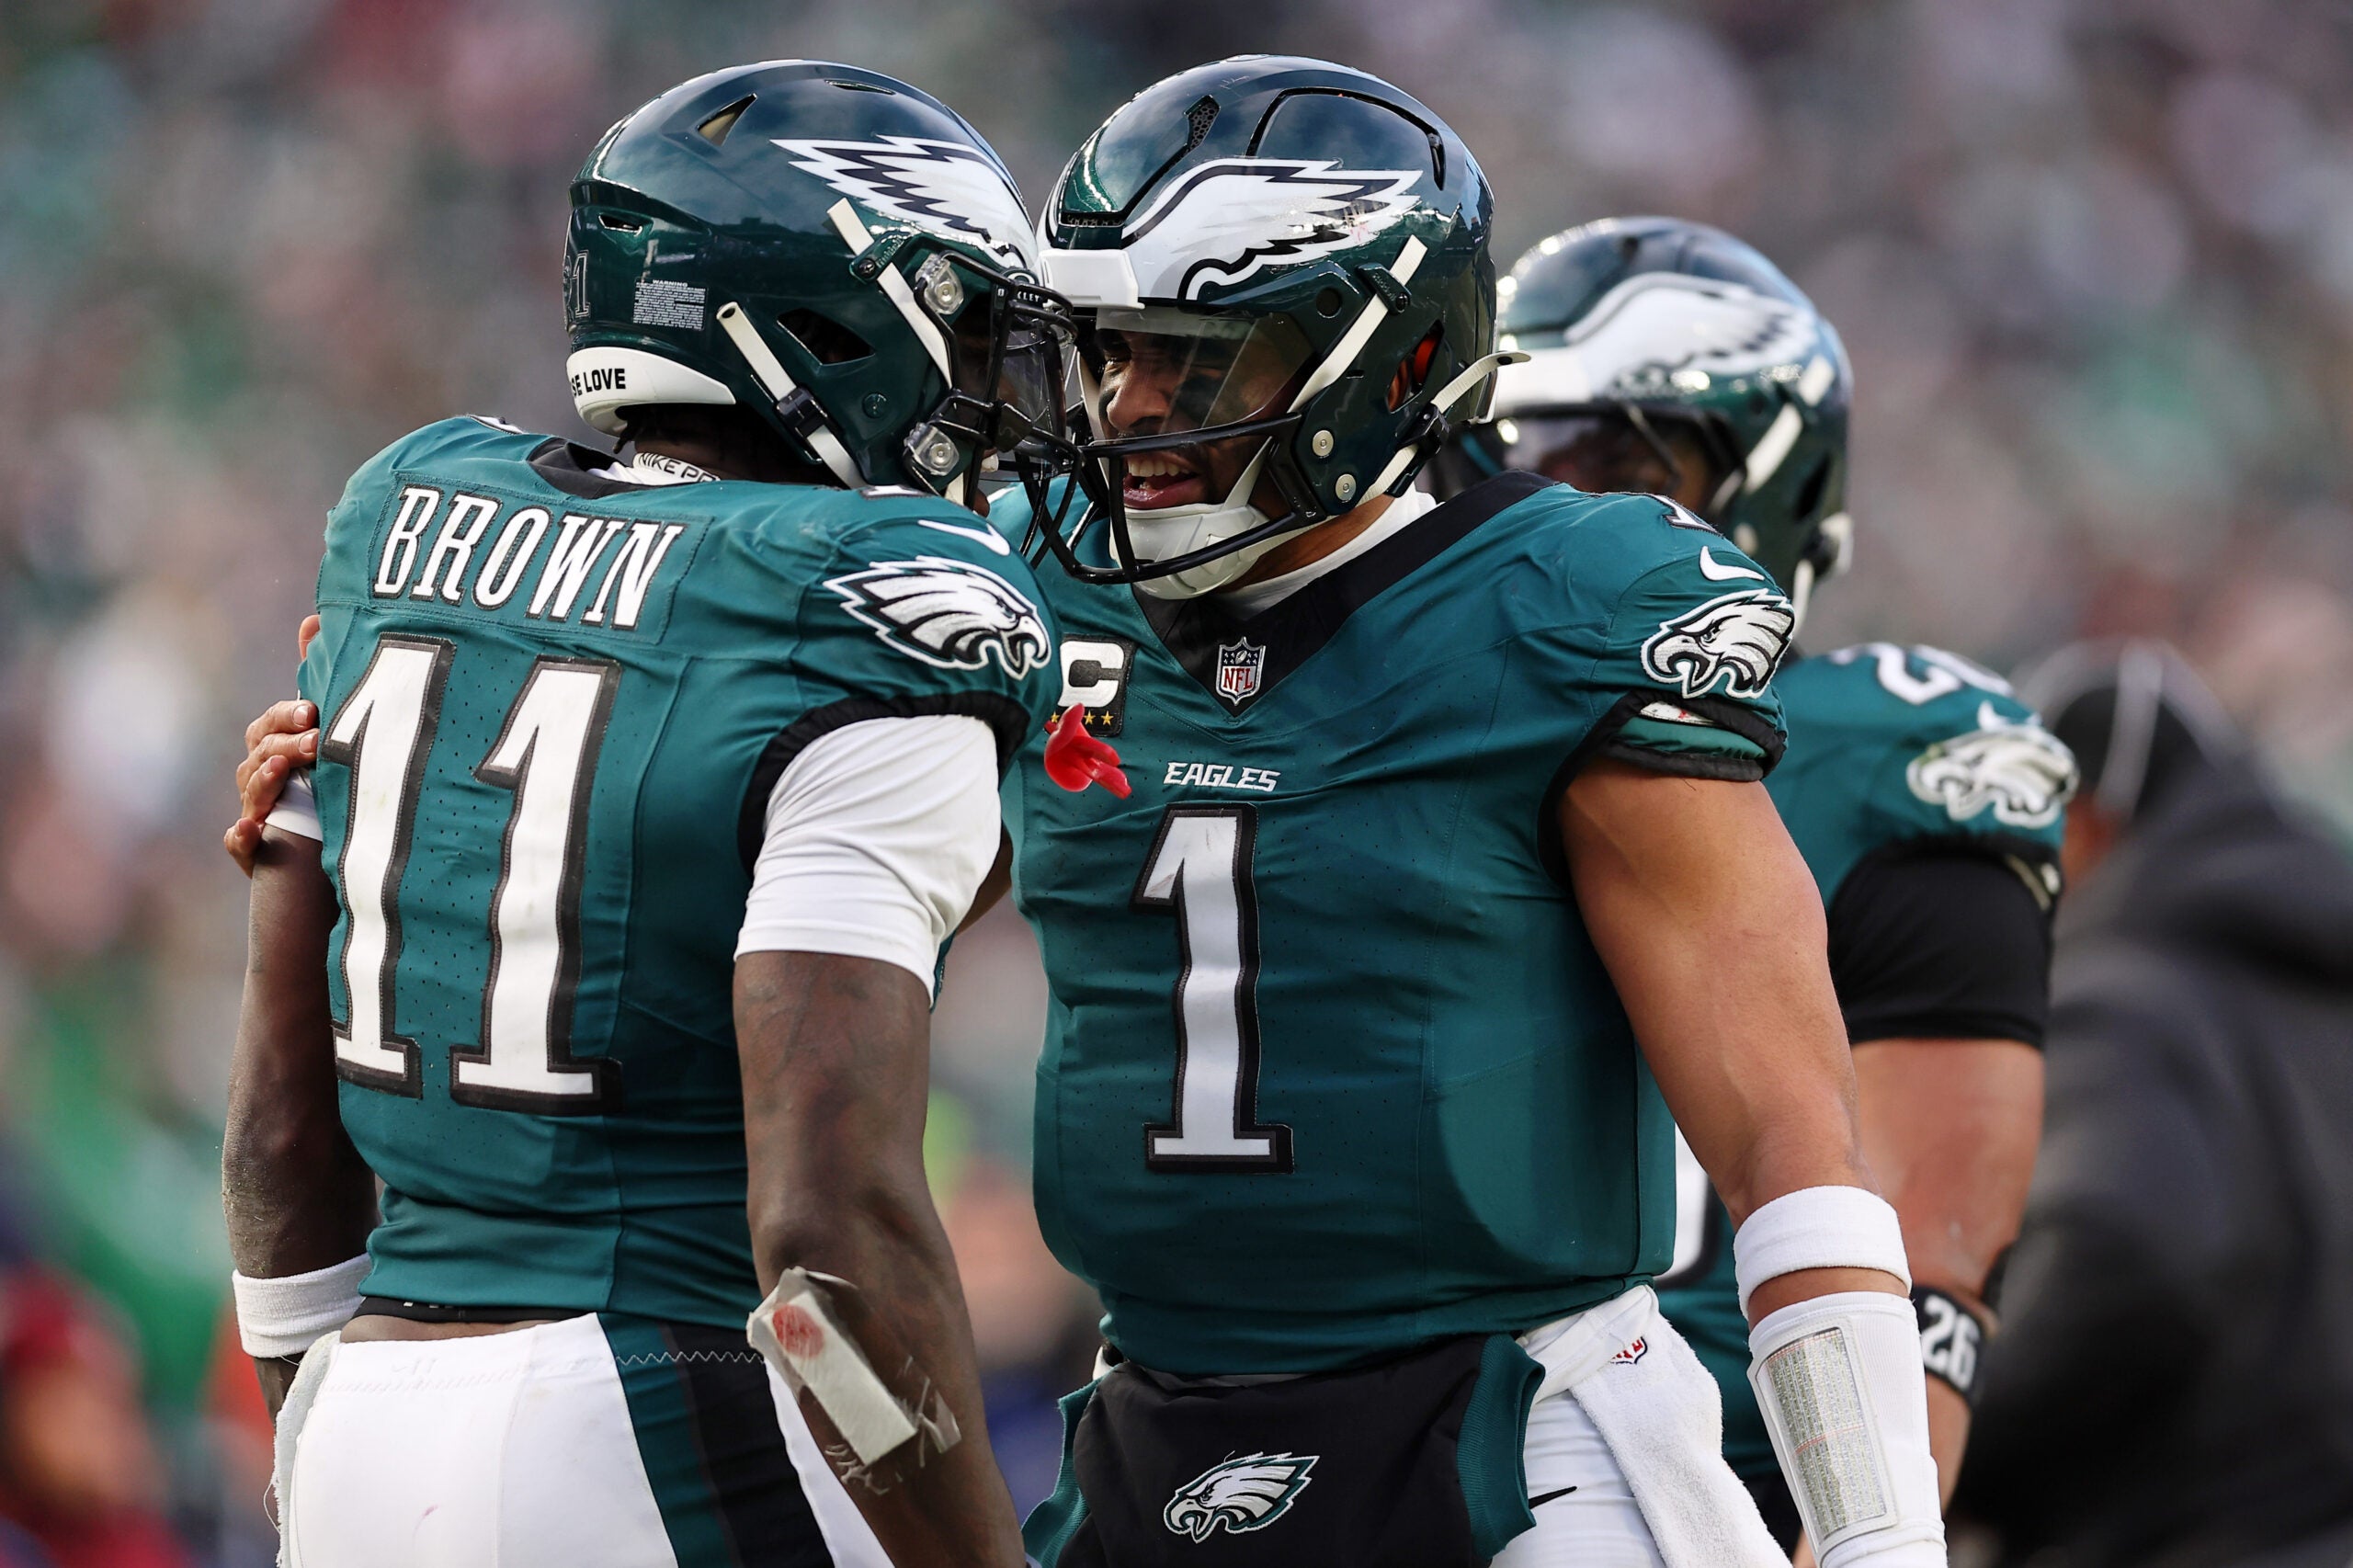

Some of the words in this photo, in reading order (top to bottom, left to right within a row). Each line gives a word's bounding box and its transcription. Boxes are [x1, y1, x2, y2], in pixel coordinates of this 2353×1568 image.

[653, 279, 688, 288] WARNING
[583, 368, 626, 392] LOVE
[639, 452, 681, 474] NIKE
[372, 483, 688, 631] BROWN
[1057, 641, 1125, 708] C
[1223, 668, 1253, 692] NFL
[1164, 762, 1281, 792] EAGLES
[322, 633, 621, 1114] 11
[1132, 806, 1285, 1167] 1
[1921, 1294, 1981, 1391] 26
